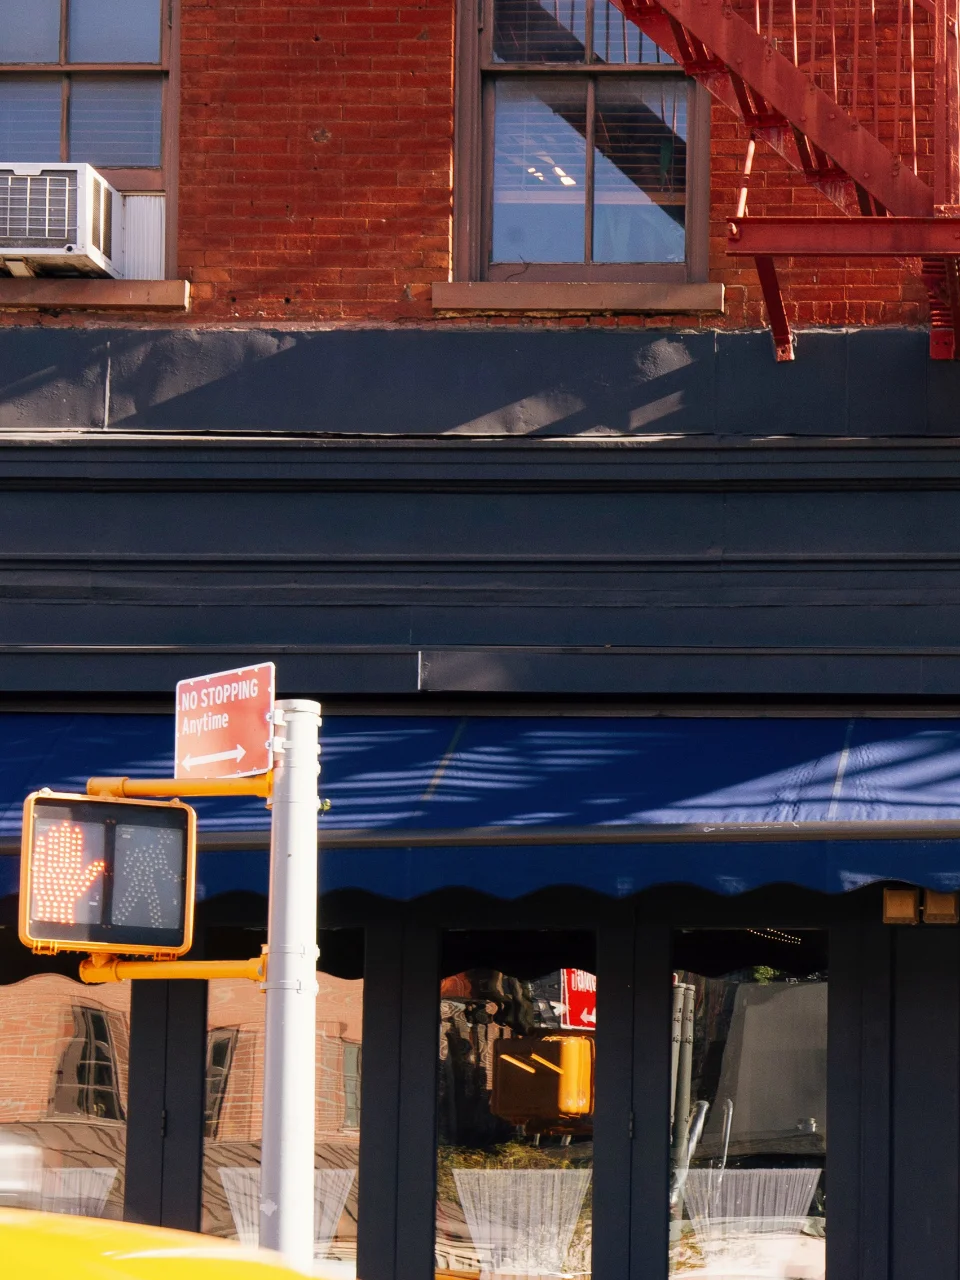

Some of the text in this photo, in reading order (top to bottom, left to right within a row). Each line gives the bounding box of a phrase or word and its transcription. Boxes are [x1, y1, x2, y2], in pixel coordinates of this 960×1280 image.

[181, 679, 259, 711] NO STOPPING
[181, 712, 229, 737] Anytime
